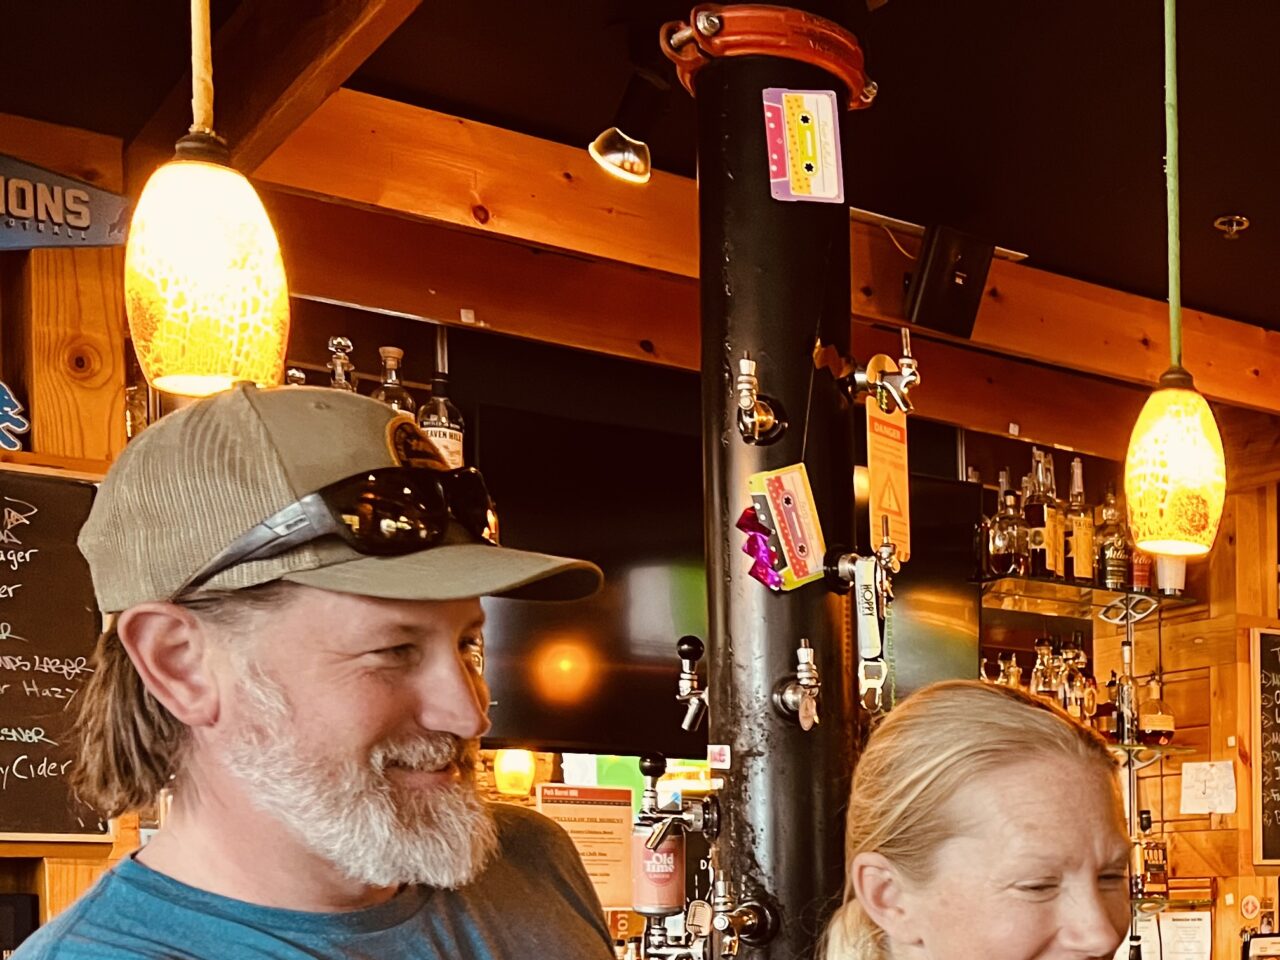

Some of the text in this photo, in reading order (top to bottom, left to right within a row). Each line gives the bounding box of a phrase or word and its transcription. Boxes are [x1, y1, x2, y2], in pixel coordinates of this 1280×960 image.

[862, 584, 875, 617] HOPPY
[23, 679, 79, 712] Hazy
[12, 755, 73, 780] Cider
[645, 861, 675, 873] Time
[652, 852, 675, 864] Old
